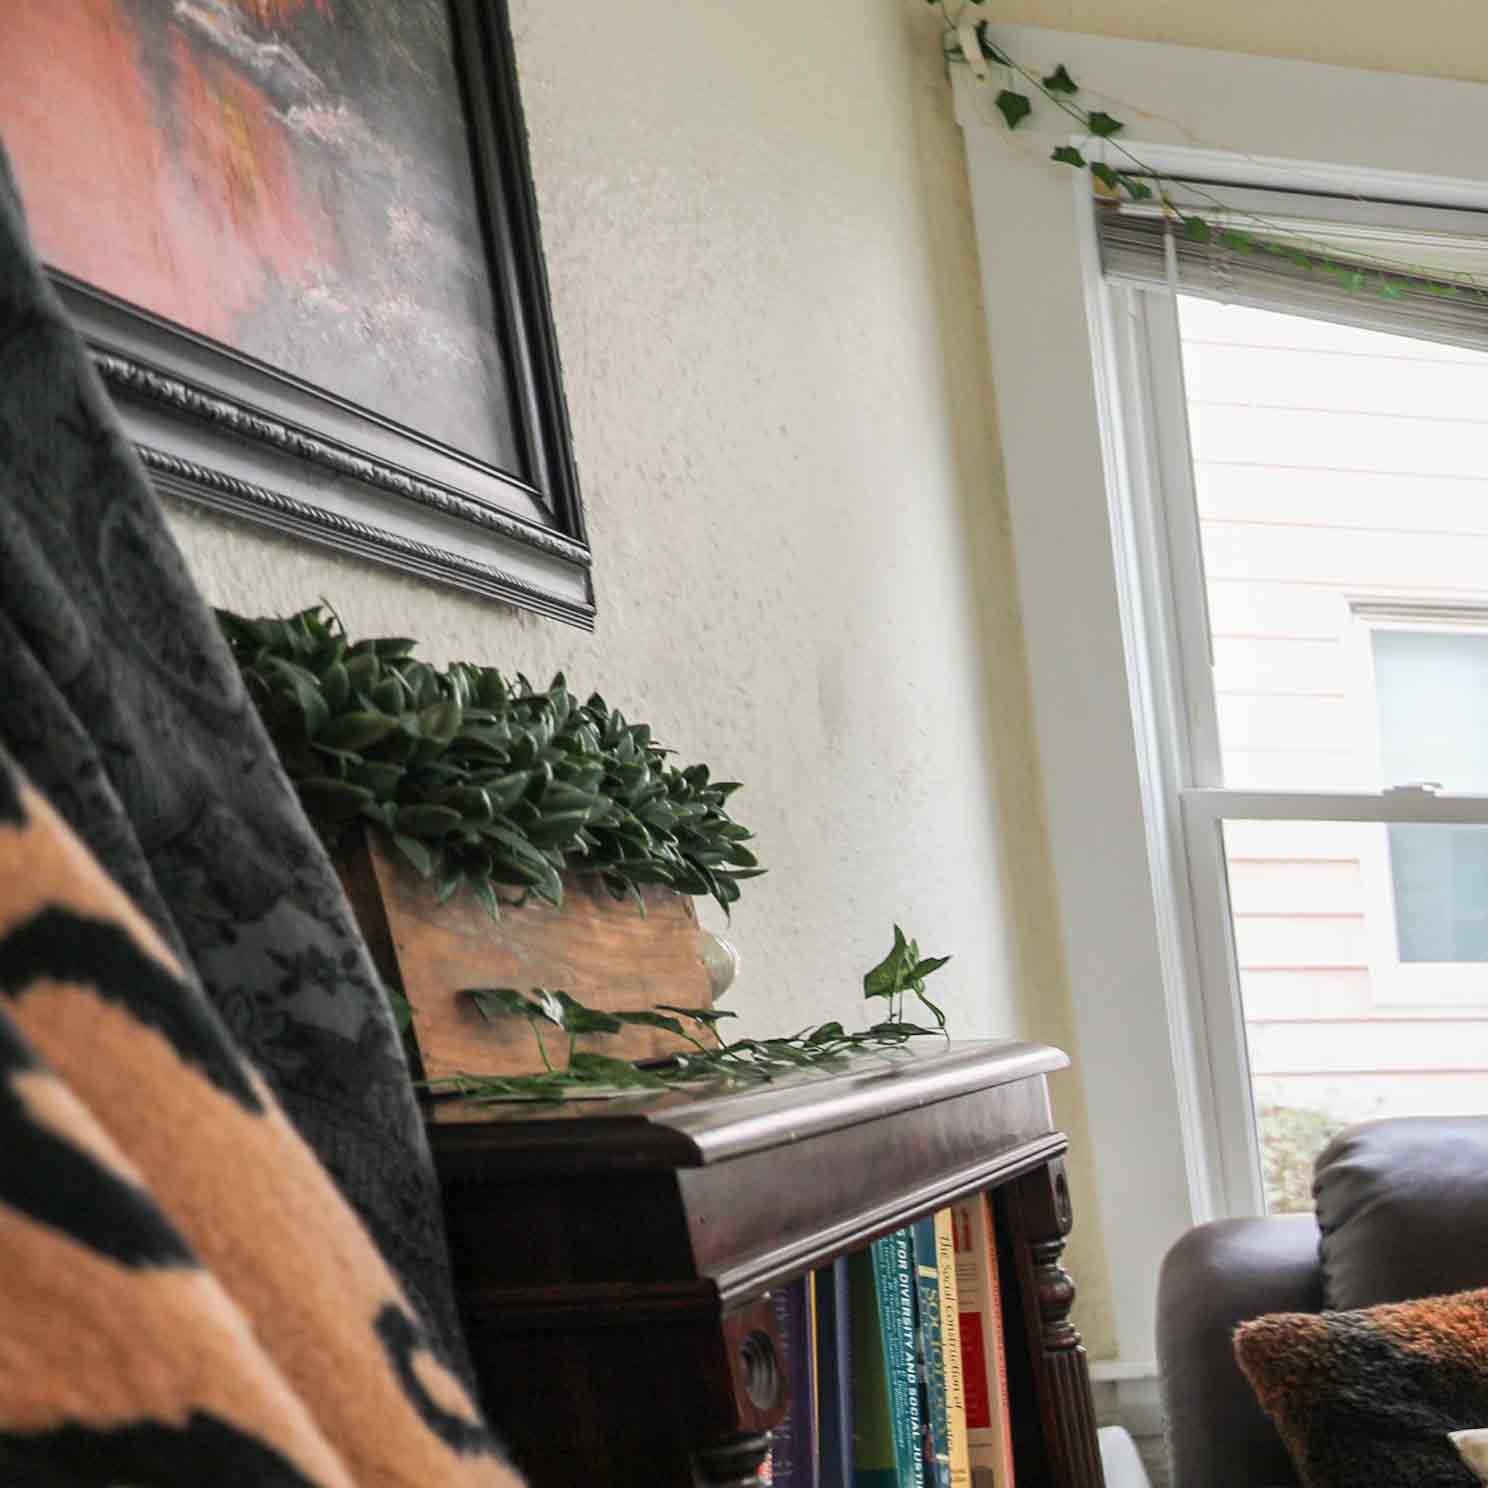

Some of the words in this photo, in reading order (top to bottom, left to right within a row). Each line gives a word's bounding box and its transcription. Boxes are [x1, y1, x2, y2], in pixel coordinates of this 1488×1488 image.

[896, 1239, 910, 1271] FOR
[898, 1272, 915, 1350] DIVERSITY
[904, 1350, 917, 1384] AND
[908, 1388, 921, 1441] SOCIAL
